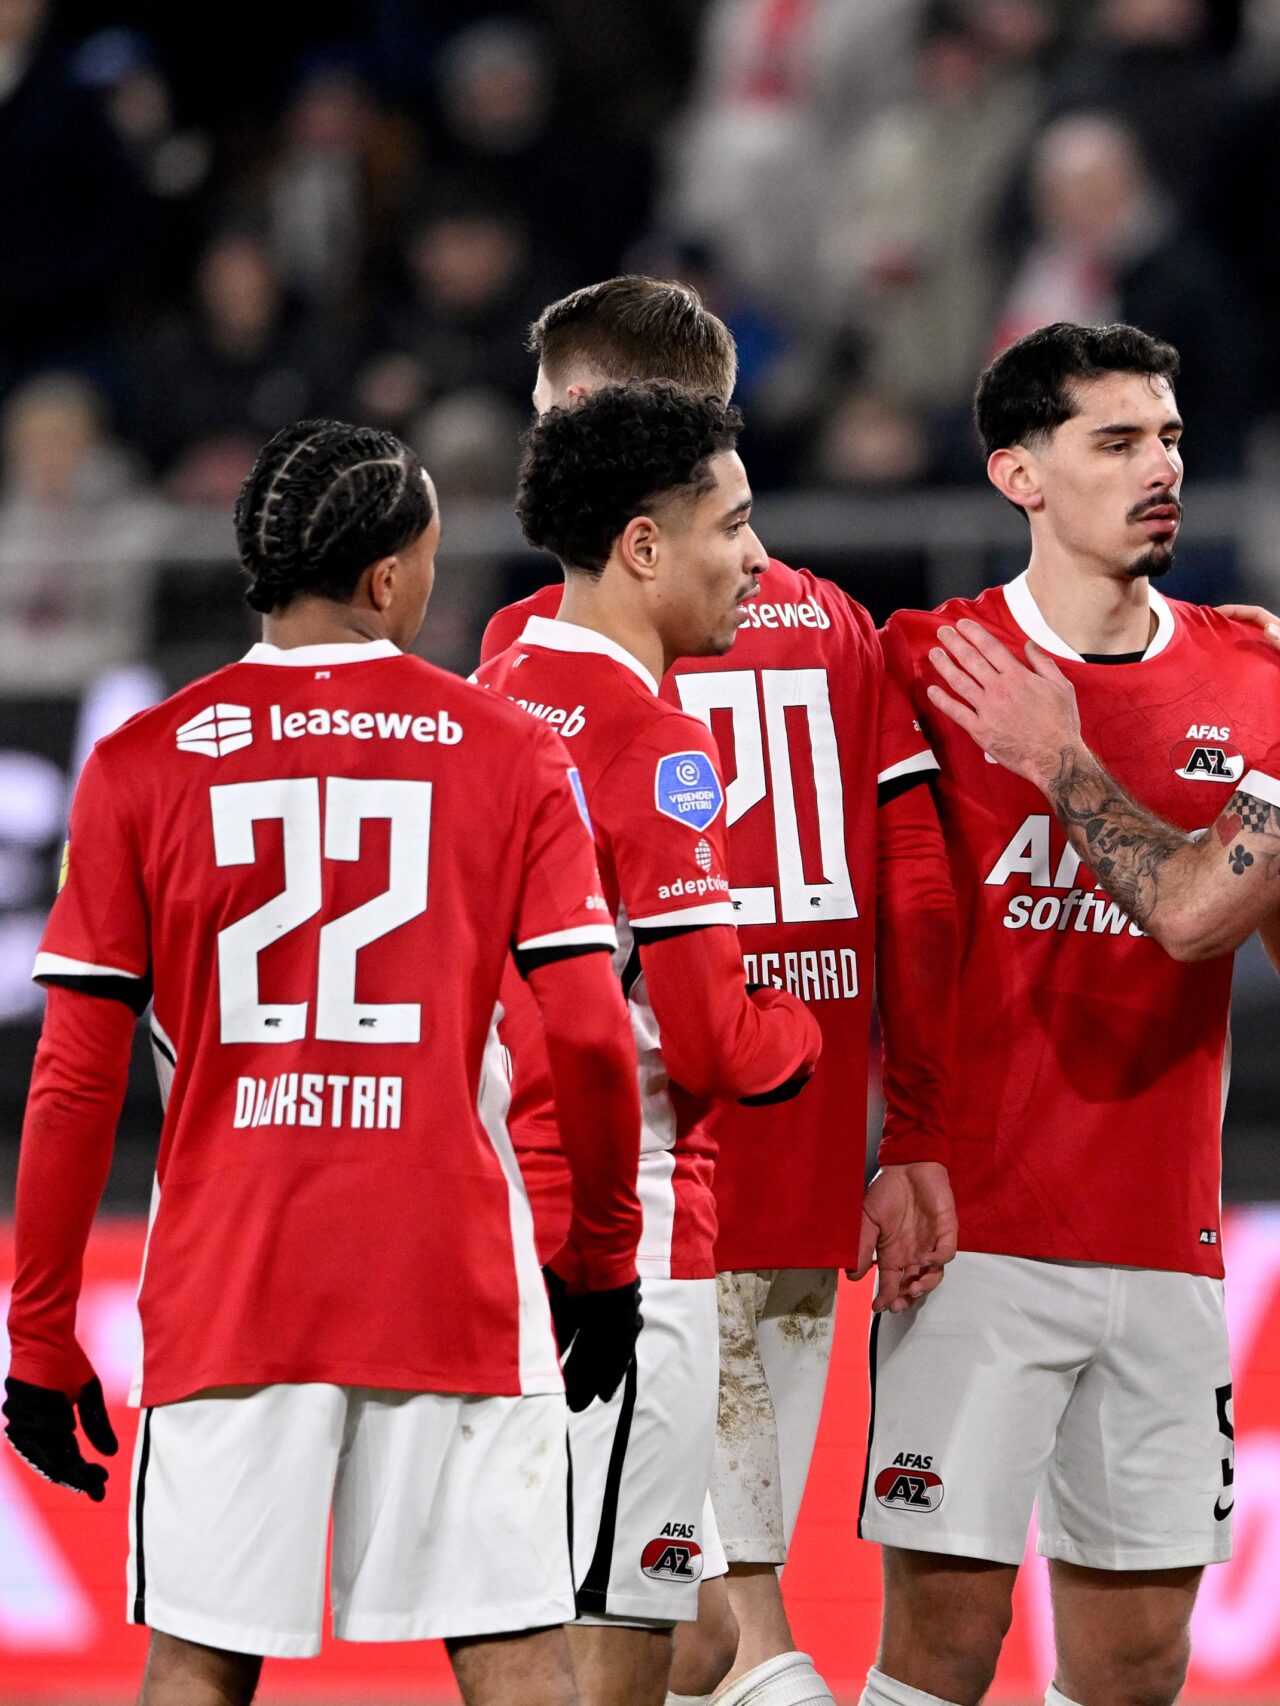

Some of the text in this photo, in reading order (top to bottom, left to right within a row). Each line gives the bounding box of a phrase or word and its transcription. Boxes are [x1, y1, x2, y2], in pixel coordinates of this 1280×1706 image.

[269, 704, 464, 746] leaseweb
[1185, 724, 1231, 741] AFAS
[668, 790, 715, 804] VRIENDEN
[674, 668, 859, 925] 20
[209, 776, 433, 1045] 22
[233, 1073, 403, 1129] DIJKSTRA
[892, 1451, 934, 1470] AFAS
[885, 1475, 932, 1508] AZ
[659, 1522, 696, 1539] AFAS
[650, 1546, 695, 1578] AZ
